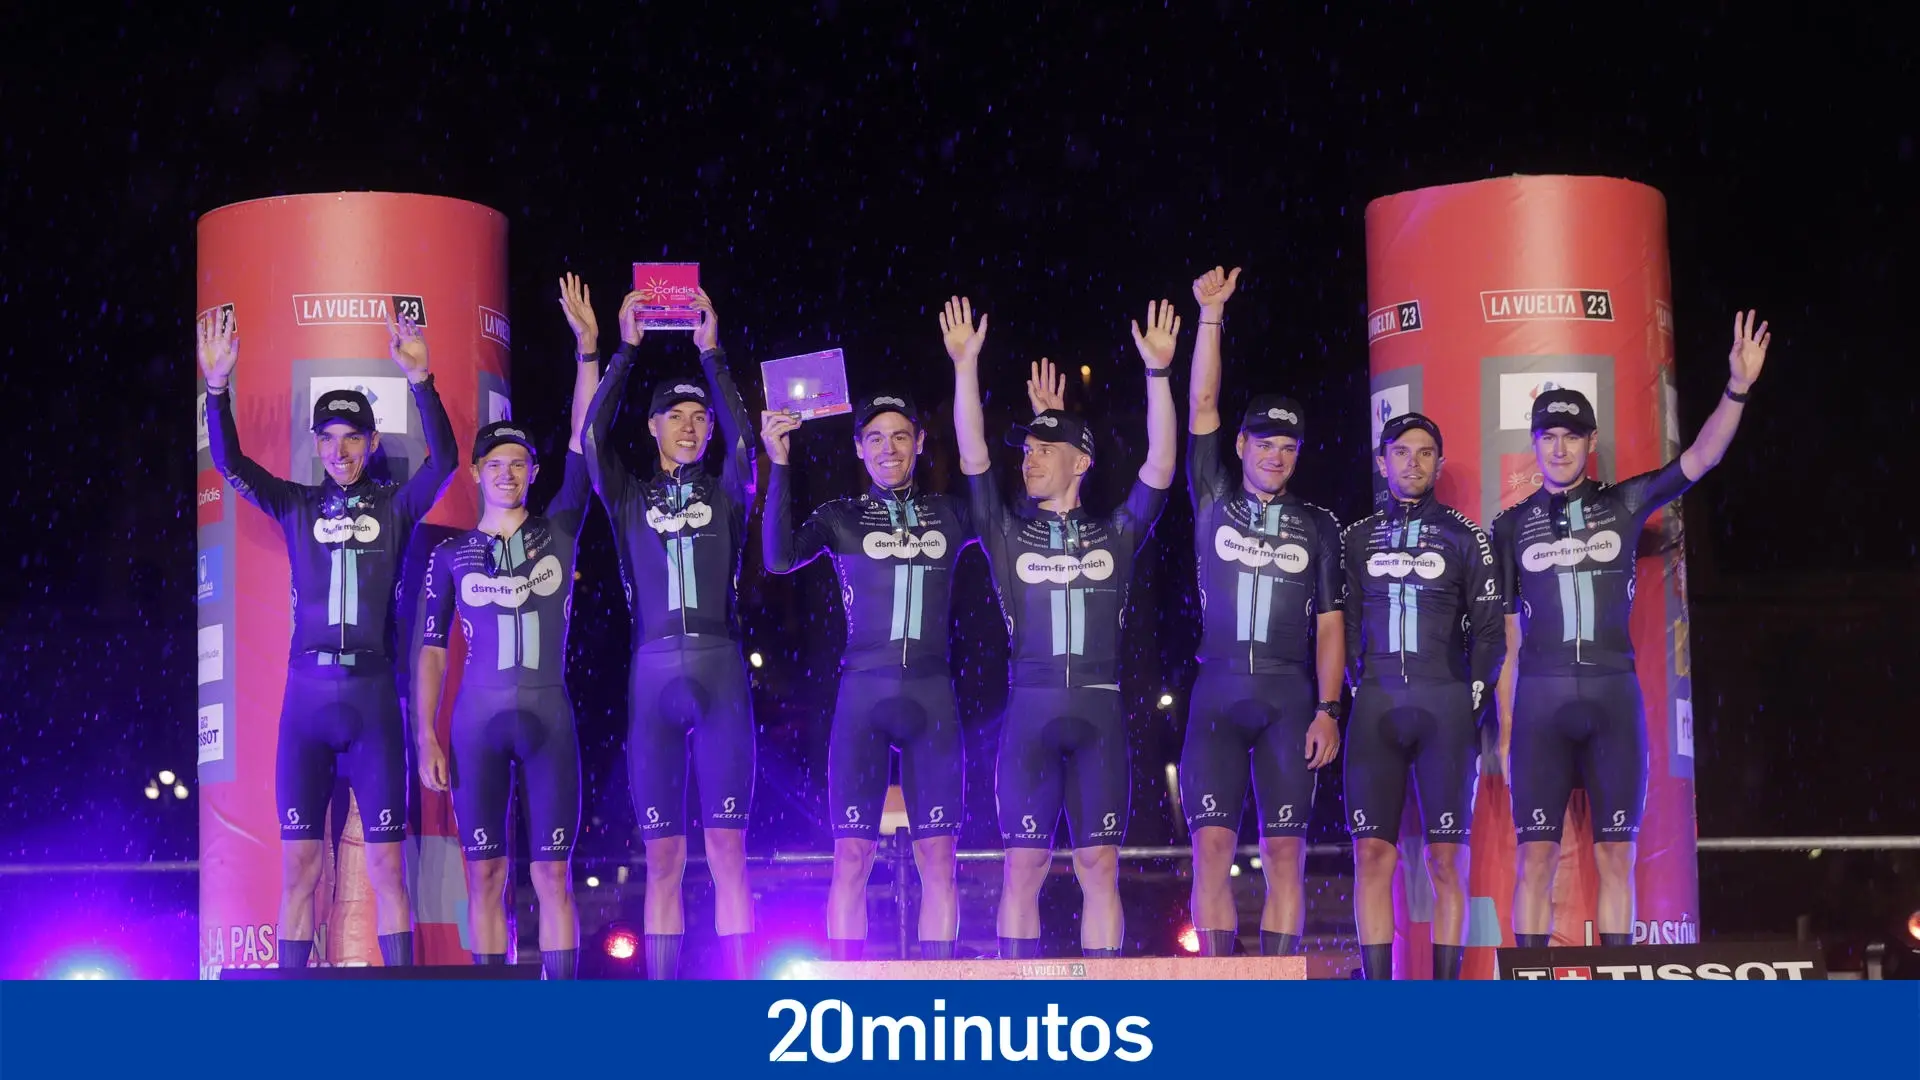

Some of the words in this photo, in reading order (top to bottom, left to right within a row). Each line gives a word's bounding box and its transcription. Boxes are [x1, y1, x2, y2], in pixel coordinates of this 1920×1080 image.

[653, 286, 695, 294] Cofidis
[304, 299, 322, 319] LA
[325, 299, 388, 319] VUELTA
[400, 300, 419, 321] 23
[1492, 296, 1511, 316] LA
[1513, 294, 1576, 314] VUELTA
[1587, 294, 1607, 315] 23
[1402, 306, 1417, 328] 23
[1035, 964, 1067, 976] VUELTA
[1072, 964, 1084, 976] 23
